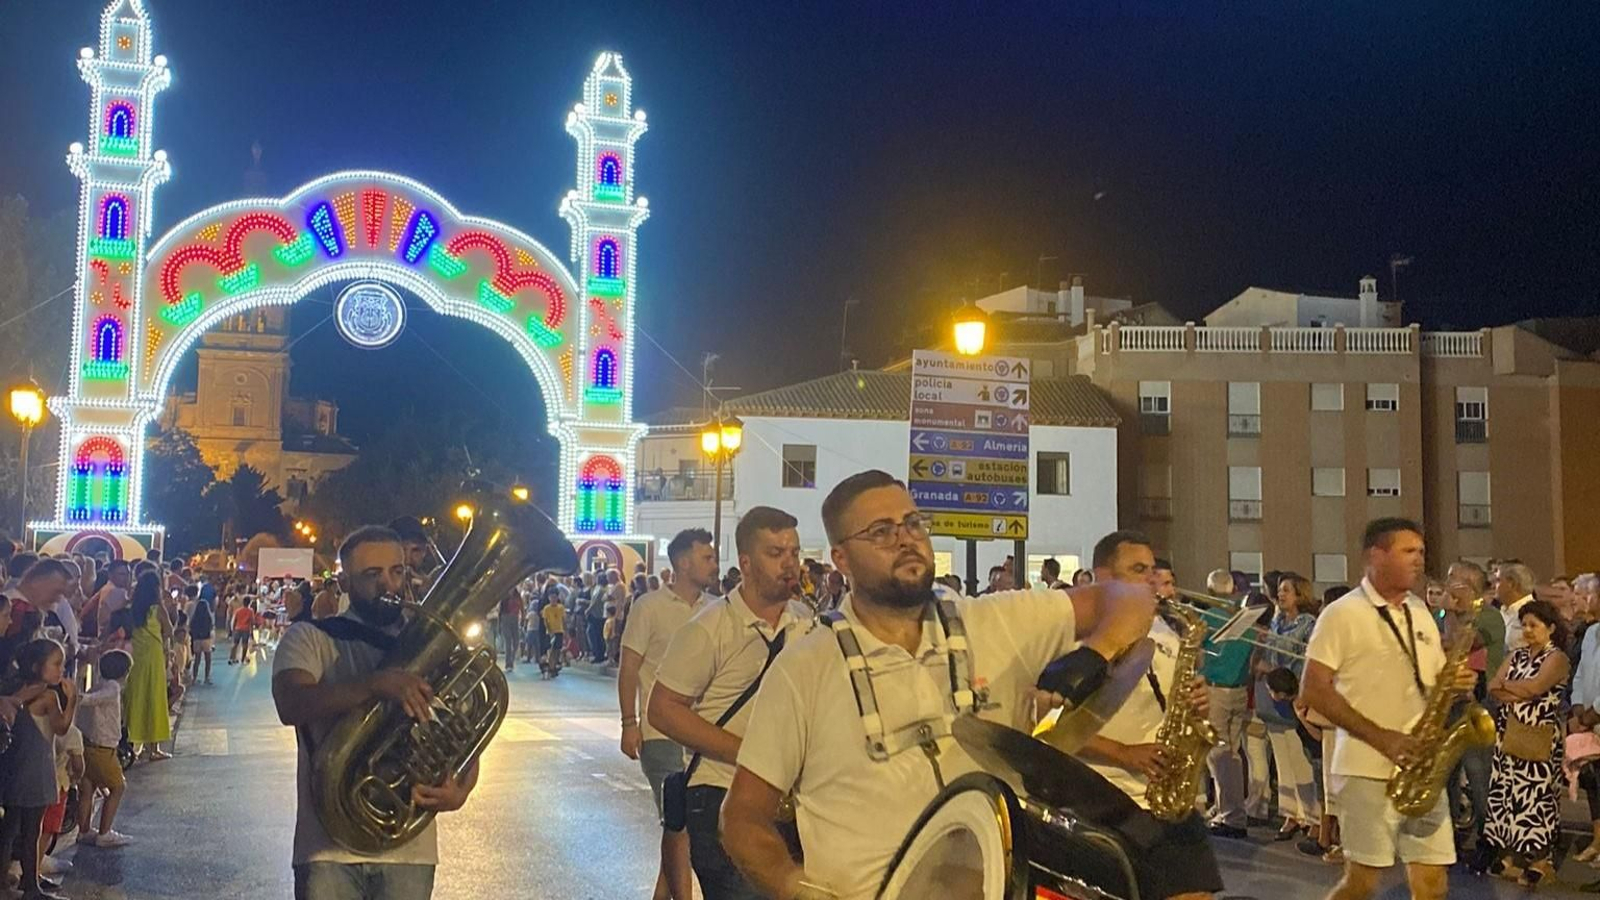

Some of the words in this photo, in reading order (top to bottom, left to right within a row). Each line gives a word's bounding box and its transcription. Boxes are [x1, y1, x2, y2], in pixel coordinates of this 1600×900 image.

[915, 358, 994, 372] ayuntamiento
[914, 390, 942, 400] local
[914, 418, 966, 427] monumental
[967, 472, 1027, 484] autobuses
[911, 488, 959, 501] Granada
[958, 520, 990, 529] turismo
